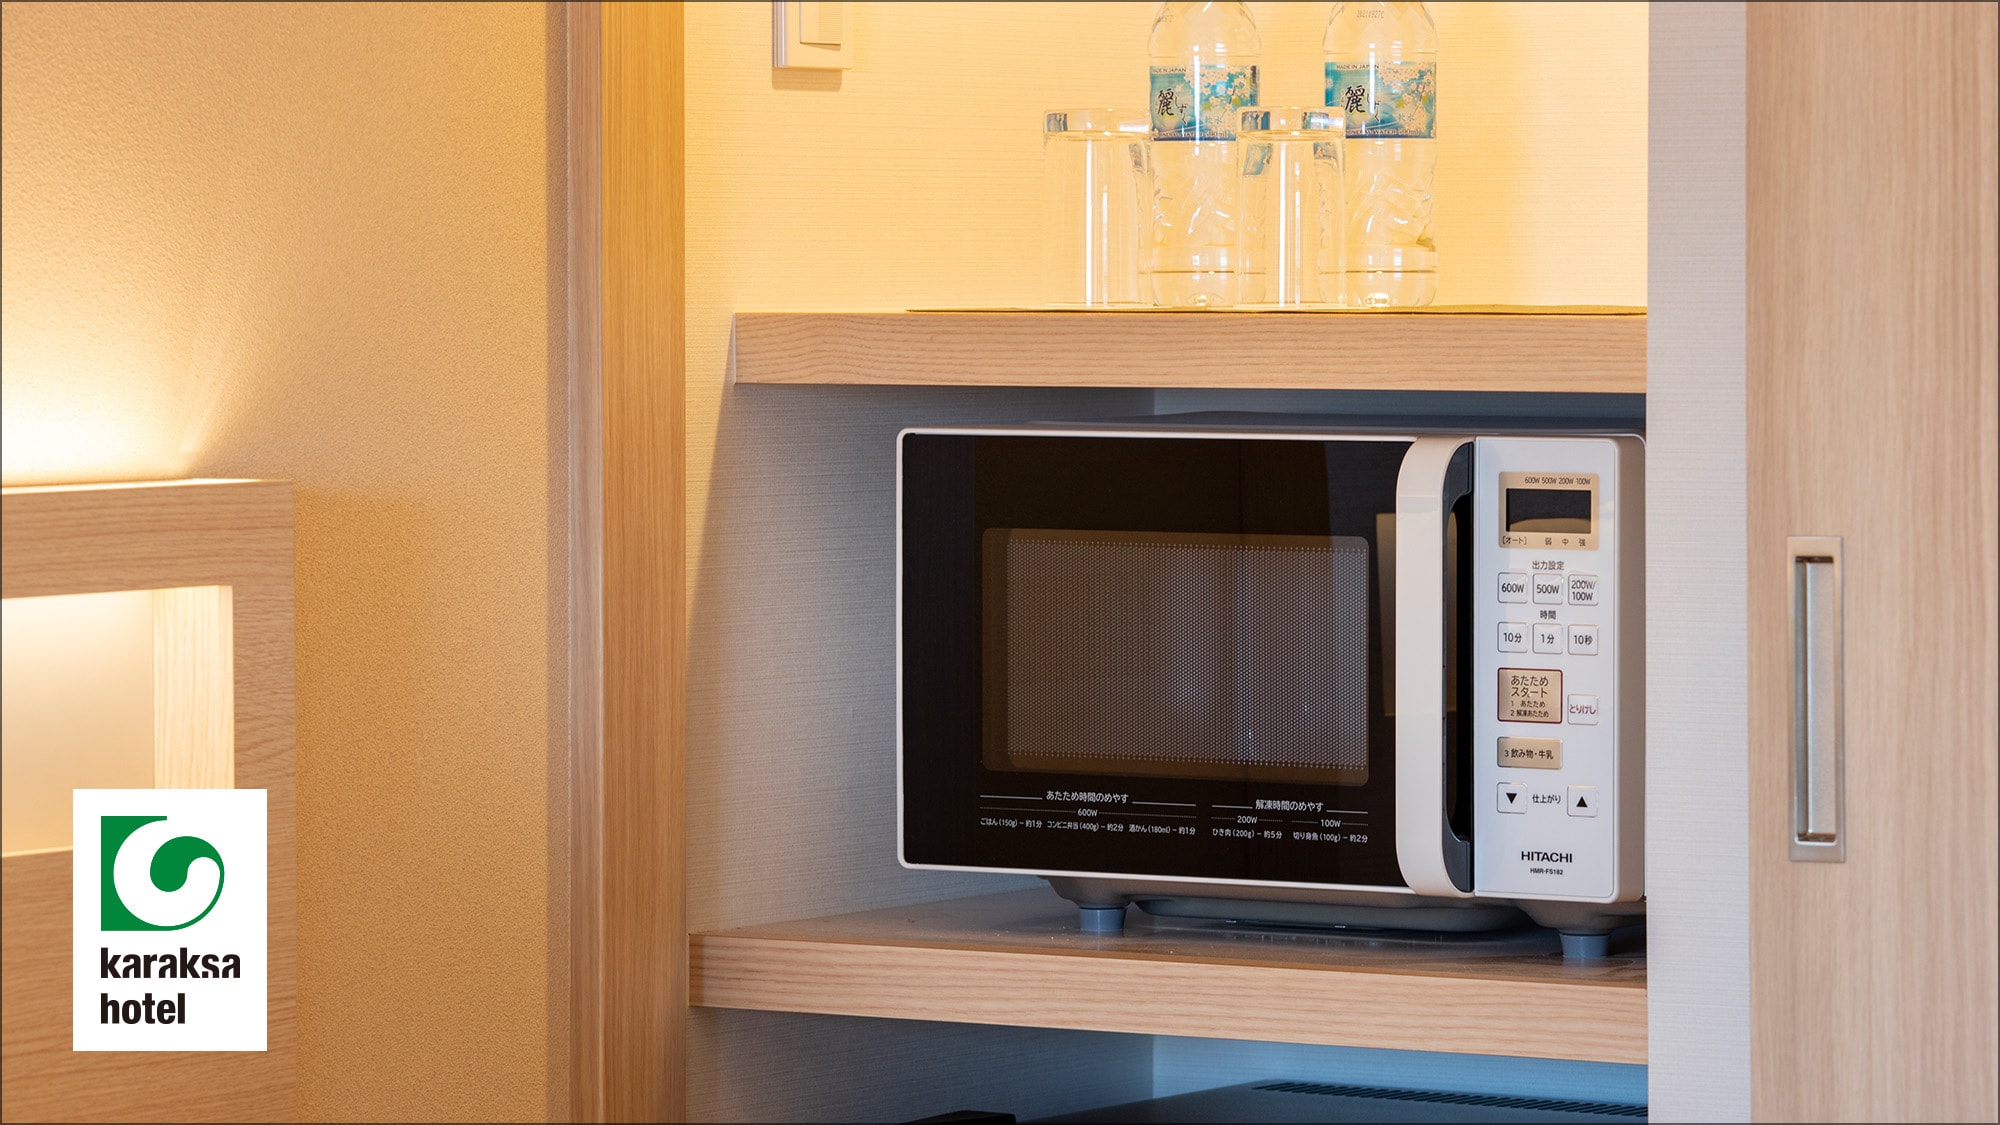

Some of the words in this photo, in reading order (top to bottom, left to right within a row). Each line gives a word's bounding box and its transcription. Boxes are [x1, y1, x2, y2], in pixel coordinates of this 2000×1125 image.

[1525, 476, 1540, 484] 600W
[1541, 476, 1557, 485] 500W
[1558, 477, 1574, 485] 200W
[1576, 477, 1591, 485] 100W
[1562, 538, 1569, 546] 中
[1578, 537, 1586, 547] 強
[1532, 560, 1565, 571] 出力設定
[1501, 583, 1524, 593] 600W
[1536, 584, 1560, 594] 500W
[1571, 579, 1596, 590] 200W/
[1572, 591, 1594, 601] 100W
[1540, 610, 1557, 620] 時間
[1503, 632, 1522, 643] 10分
[1541, 633, 1555, 645] 1分
[1574, 634, 1593, 646] 10秒
[1510, 675, 1549, 687] あたため
[1511, 686, 1548, 698] スタート
[1520, 700, 1546, 708] あたため
[1569, 704, 1597, 715] とりけし
[1046, 790, 1129, 804] あたため時間のめやす
[1532, 794, 1561, 804] 仕上がり
[1255, 799, 1324, 813] 解凍時間のめやす
[1077, 808, 1098, 817] 600W
[1237, 815, 1258, 824] 200W
[1320, 819, 1342, 828] 100W
[1521, 851, 1573, 863] HITACHI
[1530, 867, 1564, 875] HMR-FS182
